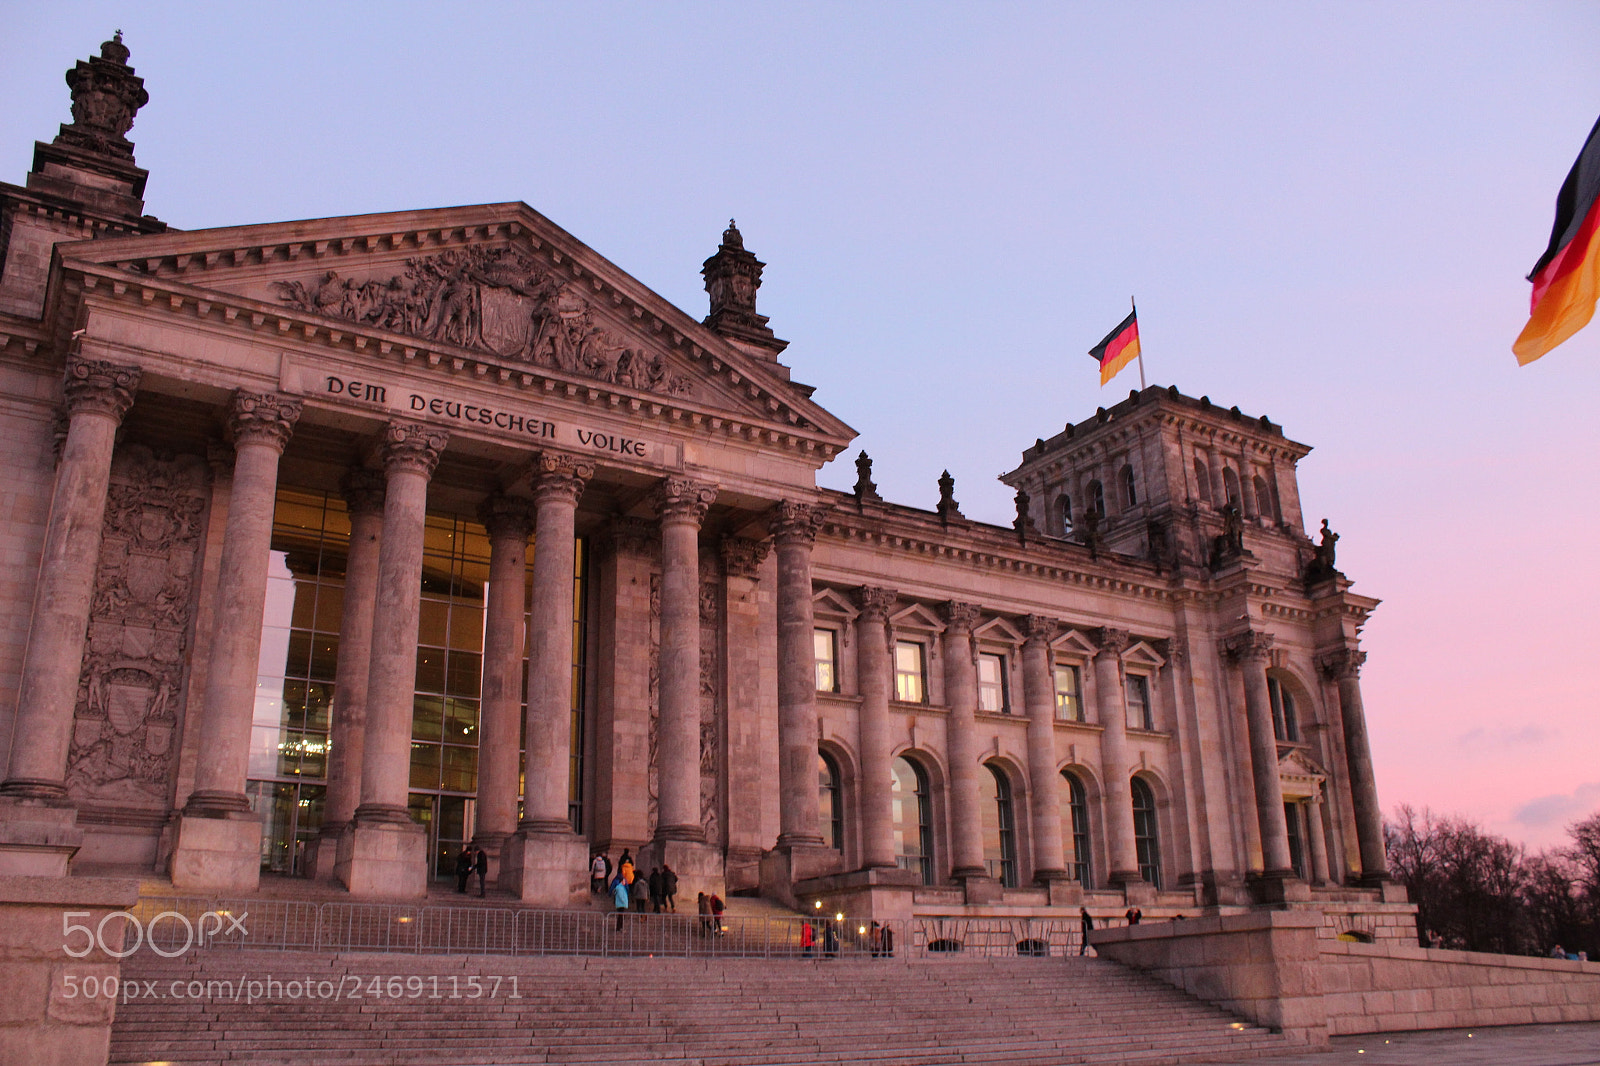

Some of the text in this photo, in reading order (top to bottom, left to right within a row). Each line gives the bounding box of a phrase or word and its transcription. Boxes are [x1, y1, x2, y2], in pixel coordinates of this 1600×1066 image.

[326, 376, 647, 457] DEM DEUTSCHEN VOLKE
